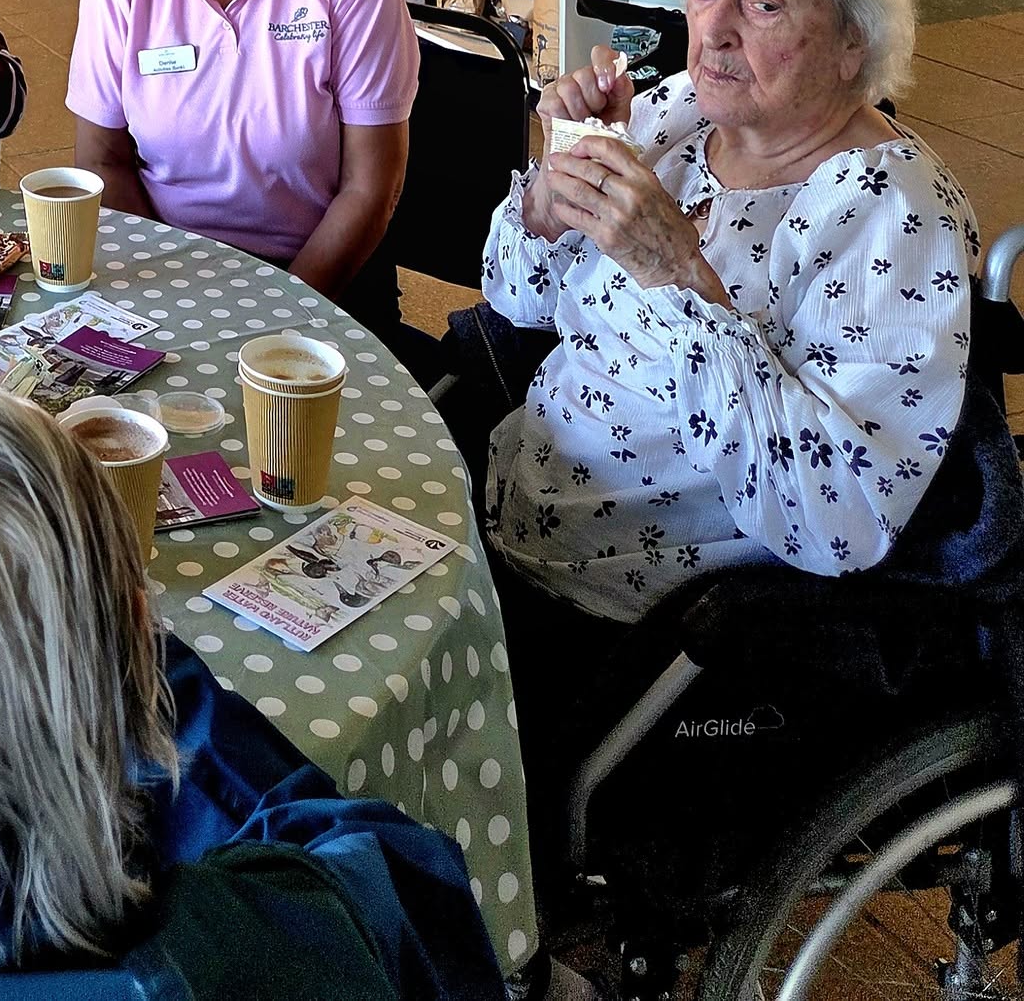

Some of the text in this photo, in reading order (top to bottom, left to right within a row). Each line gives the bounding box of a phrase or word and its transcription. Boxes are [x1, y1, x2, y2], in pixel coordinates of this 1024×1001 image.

[268, 20, 330, 33] BARCHESTER
[312, 29, 326, 43] life
[222, 590, 312, 642] RUTLAND WATER
[228, 582, 321, 635] NATURE RESERVE
[674, 718, 756, 738] AirGlide
